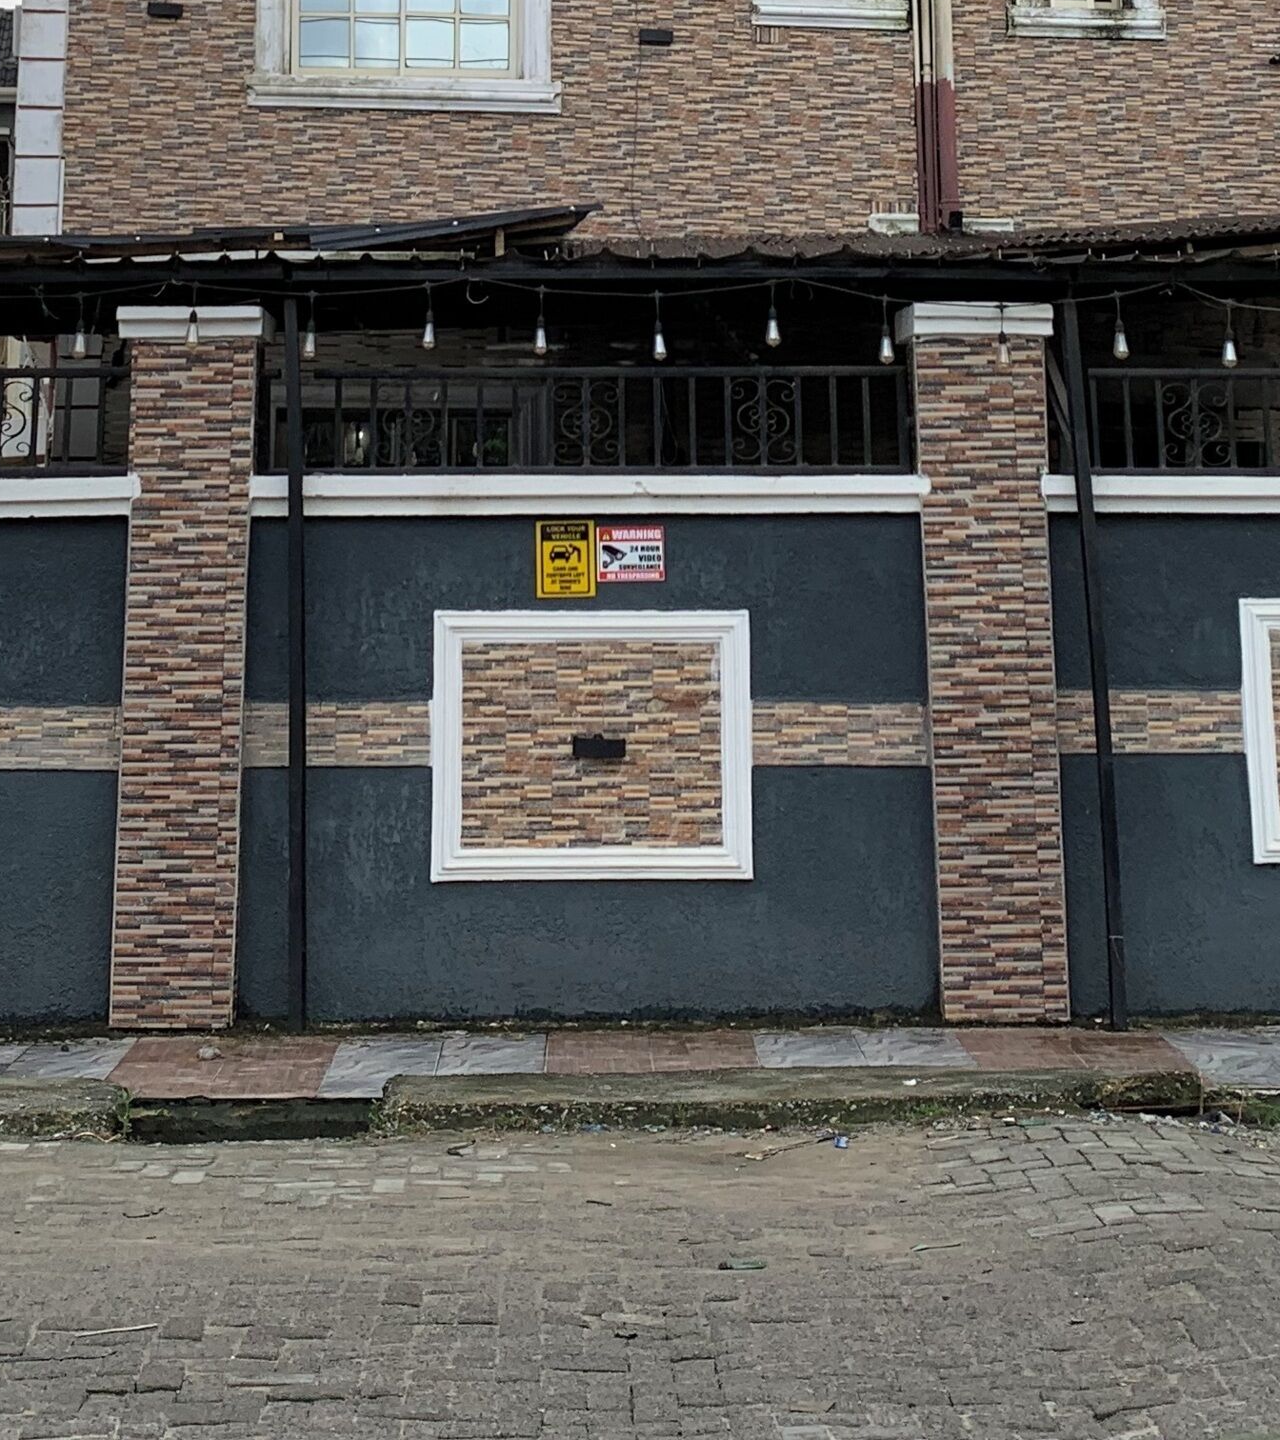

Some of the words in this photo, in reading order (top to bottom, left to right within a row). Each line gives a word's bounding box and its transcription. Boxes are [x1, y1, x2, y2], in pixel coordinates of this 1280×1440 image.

[546, 525, 565, 533] LOCK
[567, 525, 586, 533] YOUR
[611, 528, 662, 541] WARNING
[630, 545, 638, 553] 24
[640, 545, 660, 553] HOUR
[638, 554, 662, 563] VIDEO
